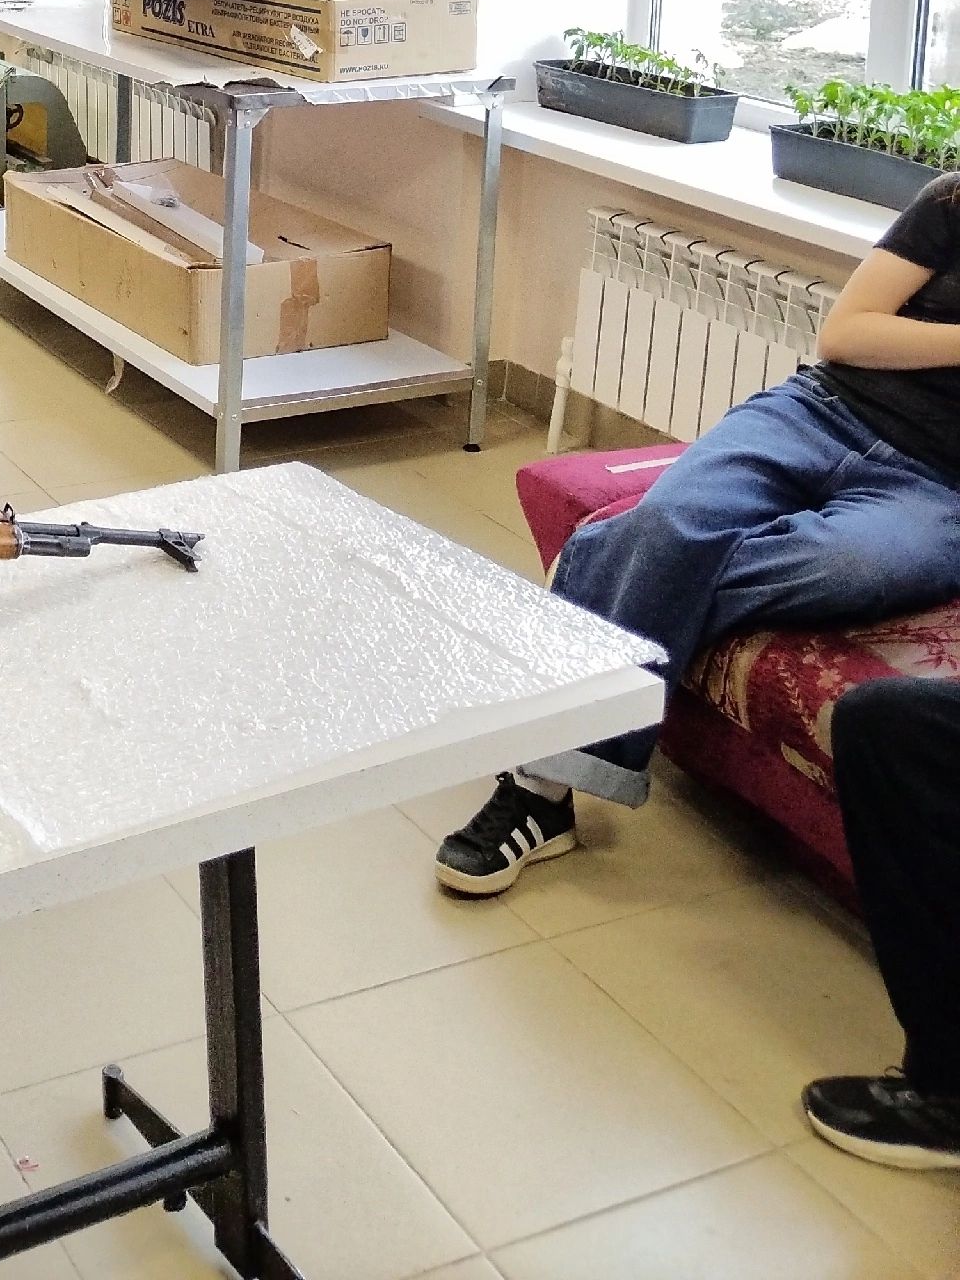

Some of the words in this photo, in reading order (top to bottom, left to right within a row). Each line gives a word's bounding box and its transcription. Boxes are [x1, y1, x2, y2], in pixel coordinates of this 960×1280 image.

[292, 13, 319, 25] ВОЗДУХА
[340, 9, 350, 18] НЕ
[340, 18, 351, 27] DO
[352, 17, 368, 26] NOT
[187, 19, 216, 38] ETRA
